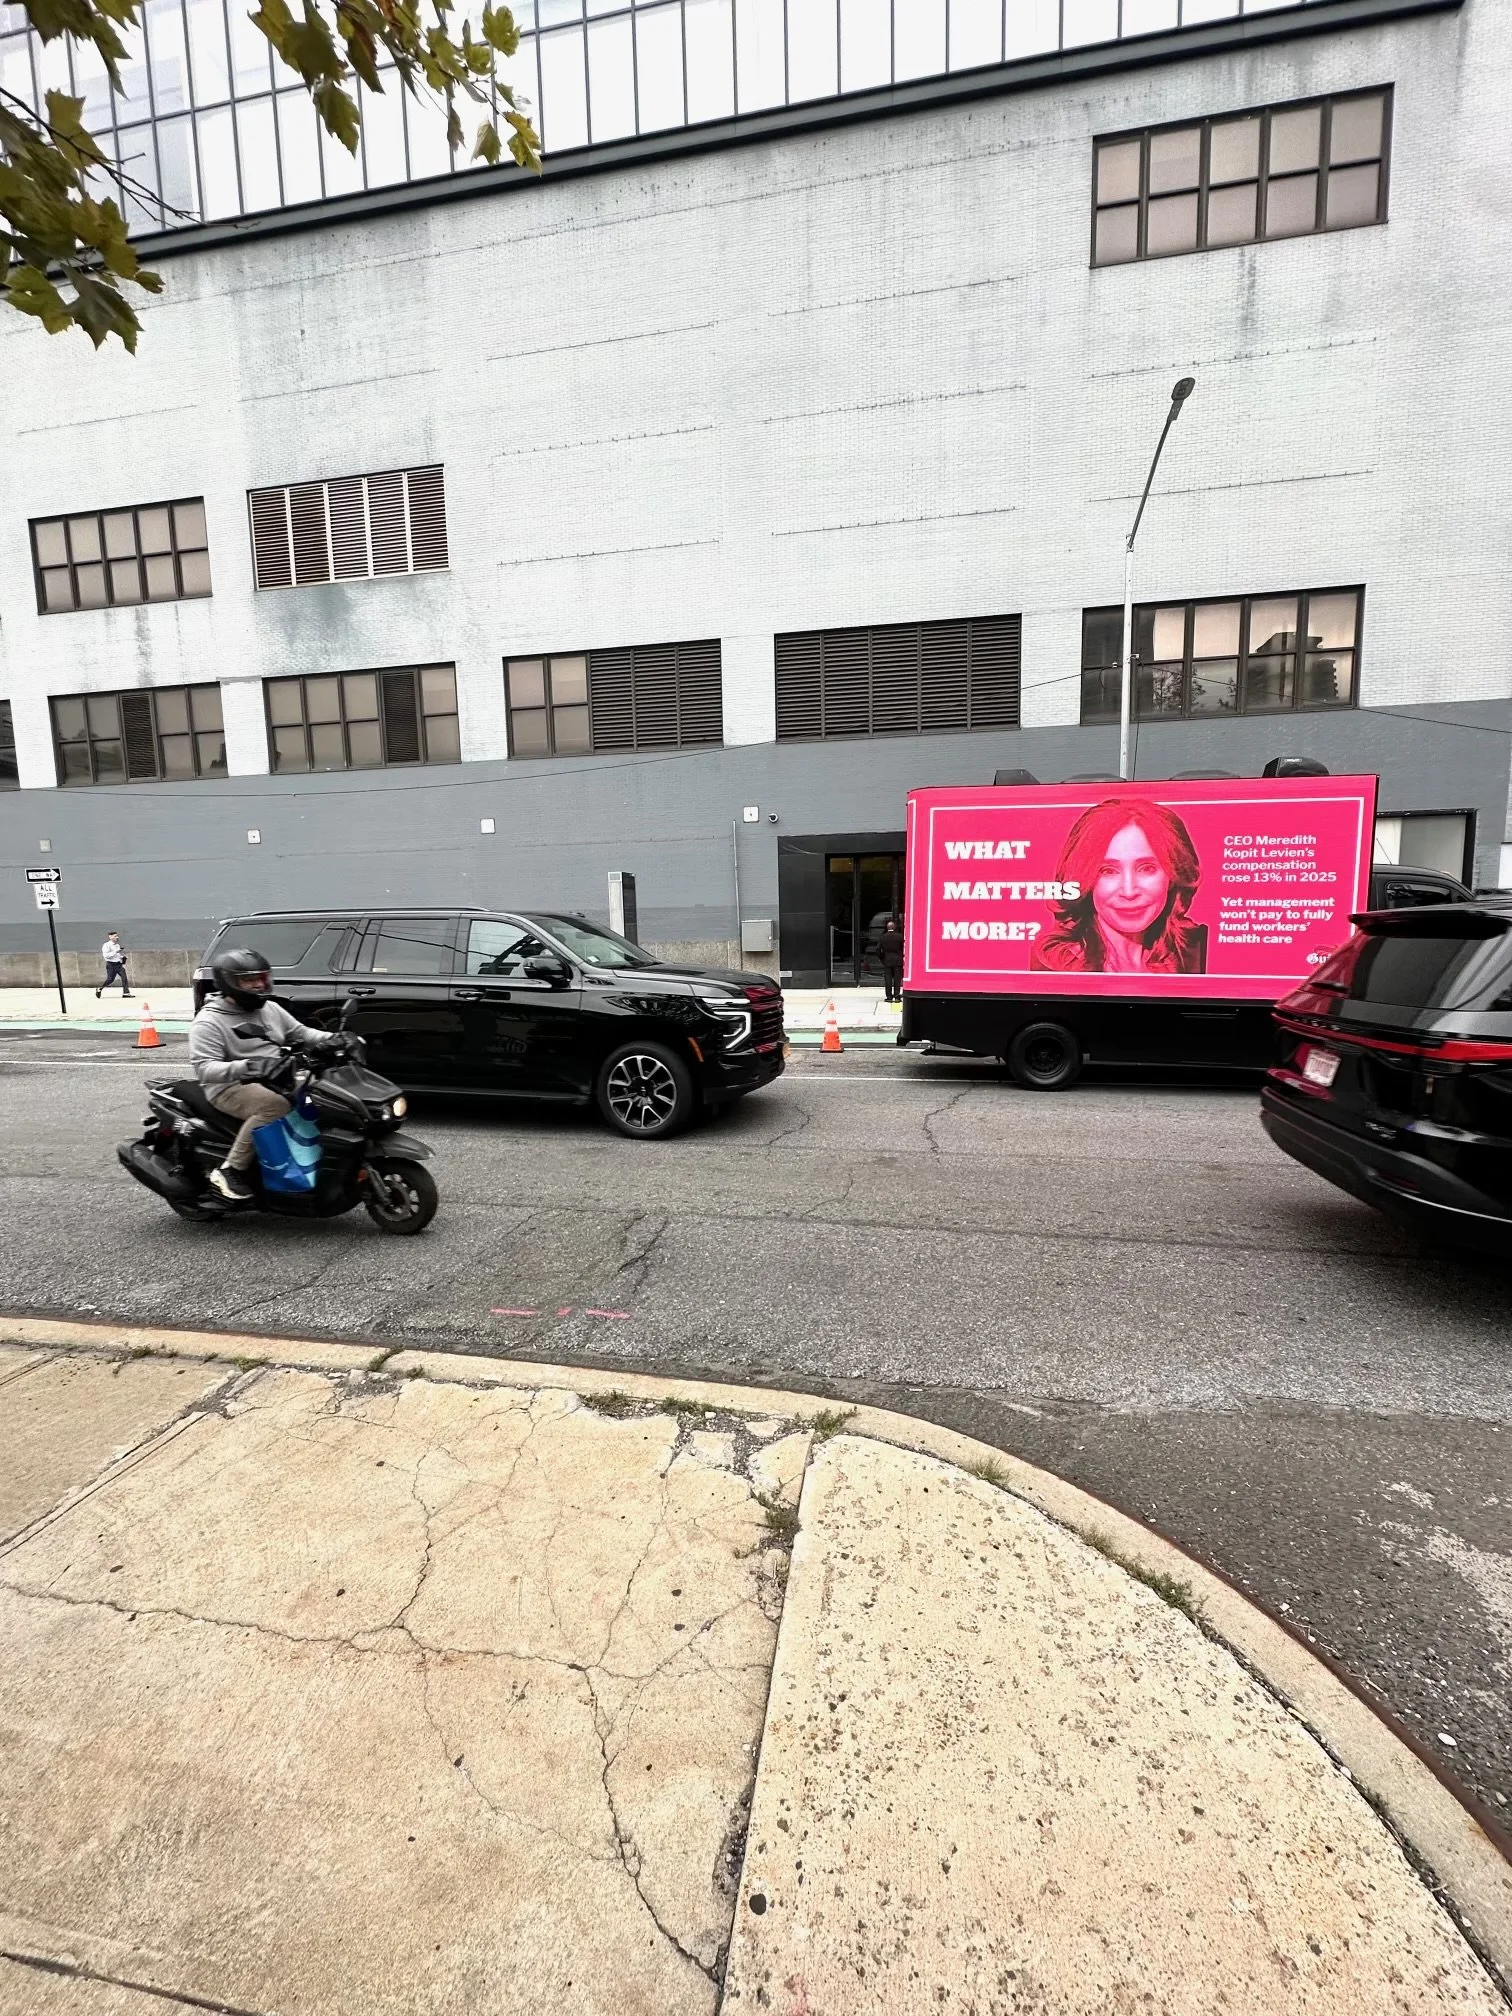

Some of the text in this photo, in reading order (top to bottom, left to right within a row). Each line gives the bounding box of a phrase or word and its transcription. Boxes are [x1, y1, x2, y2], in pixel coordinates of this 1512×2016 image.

[1224, 835, 1317, 846] CEO Meredith
[944, 841, 1031, 860] WHAT
[1223, 847, 1315, 859] Kopit Levien’s
[1222, 860, 1317, 871] compensation
[1222, 872, 1337, 883] rose 13% in 2025
[943, 881, 1081, 900] MATTERS
[1221, 897, 1335, 908] Yet management
[1220, 909, 1334, 921] won’t pay to fully
[942, 921, 1042, 940] MORE?
[1219, 921, 1311, 932] fund workers’
[1218, 933, 1293, 944] health care
